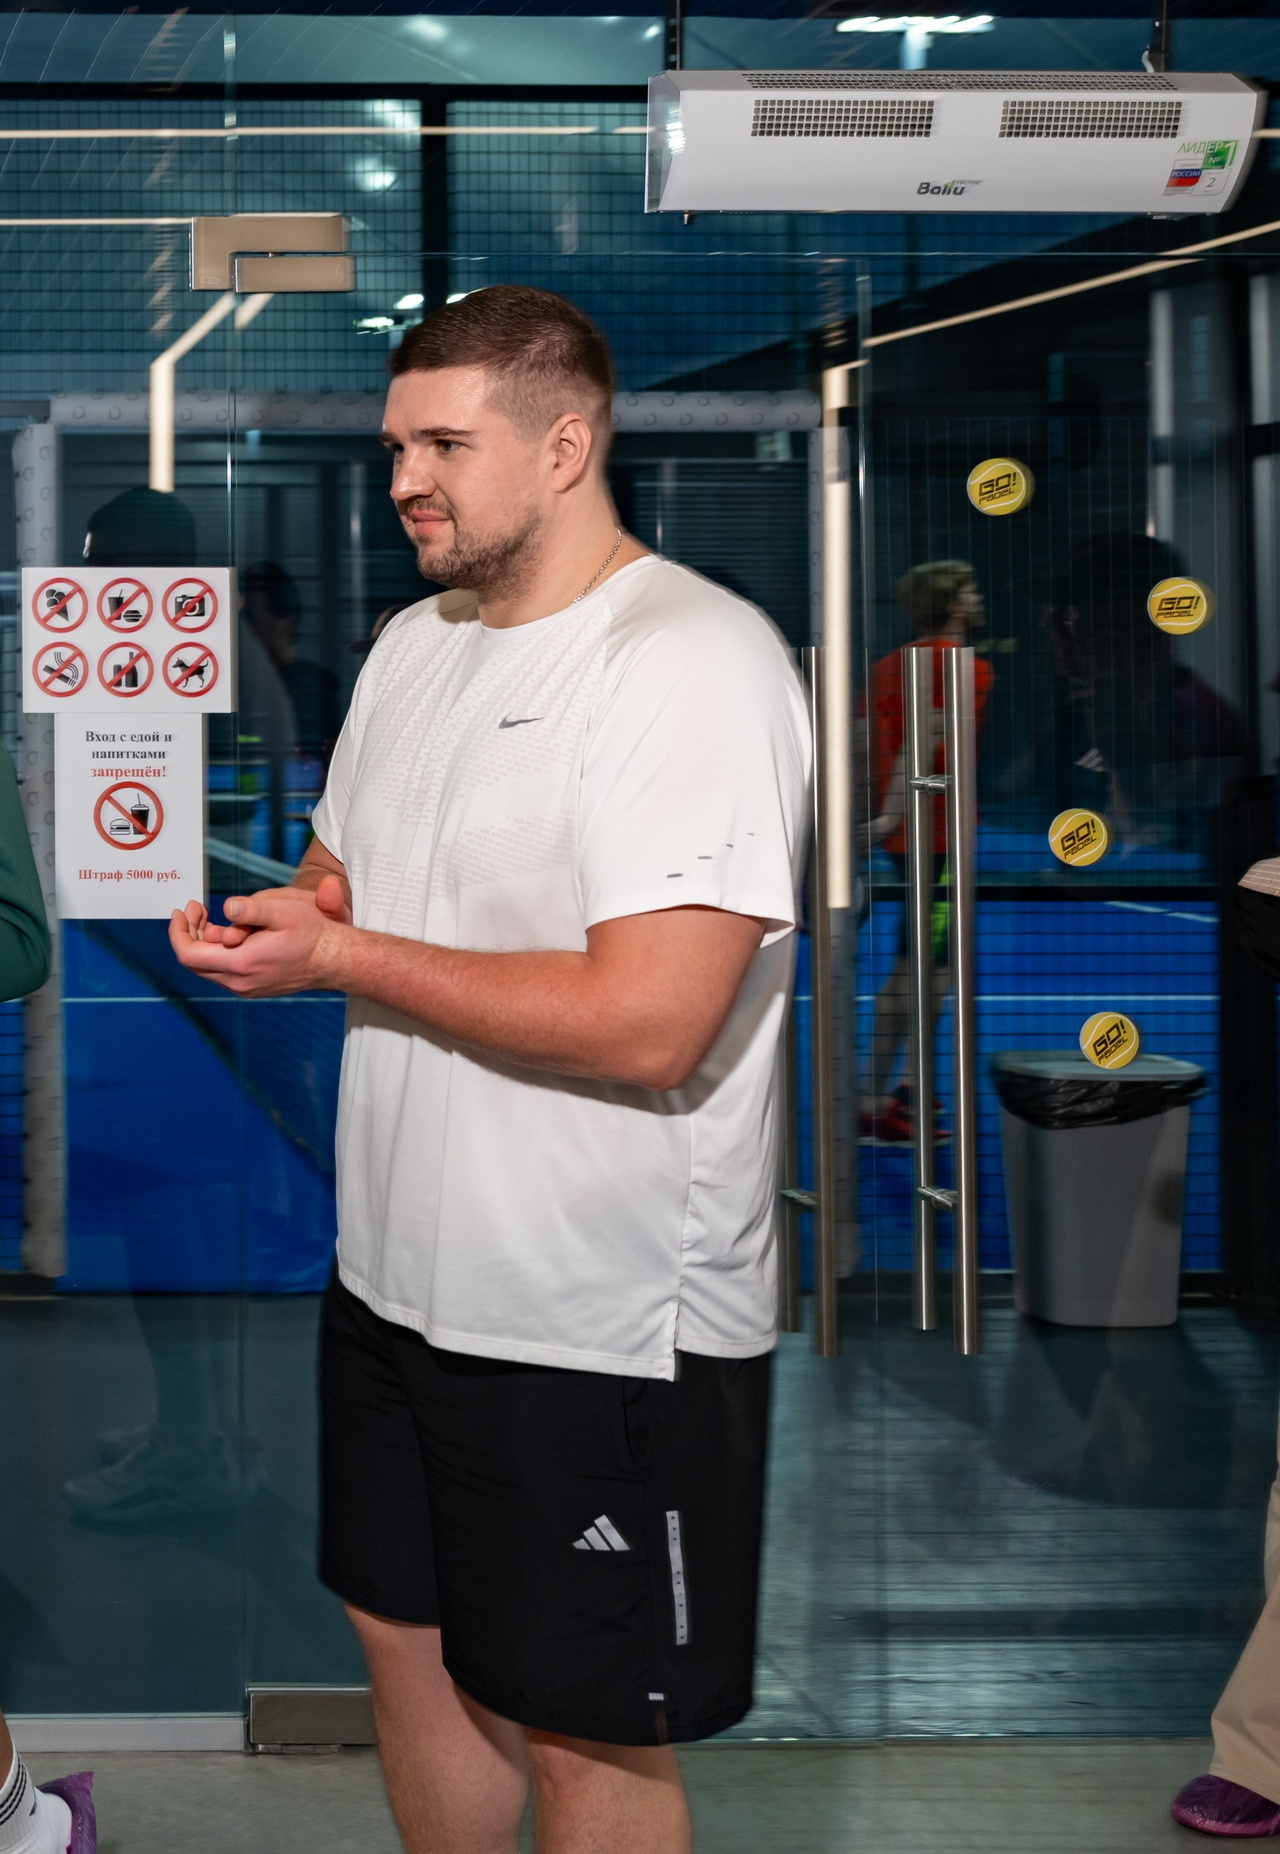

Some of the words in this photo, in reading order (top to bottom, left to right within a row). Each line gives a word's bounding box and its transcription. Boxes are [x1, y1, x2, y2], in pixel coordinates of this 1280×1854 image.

[1177, 141, 1223, 155] ЛИДЕР
[917, 179, 966, 196] Ballu
[1206, 177, 1216, 188] 2
[978, 471, 1016, 497] GO!
[1157, 595, 1200, 612] GO!
[85, 731, 116, 744] Вход
[120, 734, 126, 742] с
[130, 731, 160, 744] едой
[164, 734, 172, 742] и
[92, 750, 166, 760] напитками
[90, 766, 167, 780] запрещён!
[1060, 818, 1096, 852] GO!
[78, 869, 123, 882] Штраф
[126, 869, 154, 880] 5000
[156, 869, 181, 882] руб.
[1092, 1019, 1127, 1057] GO!
